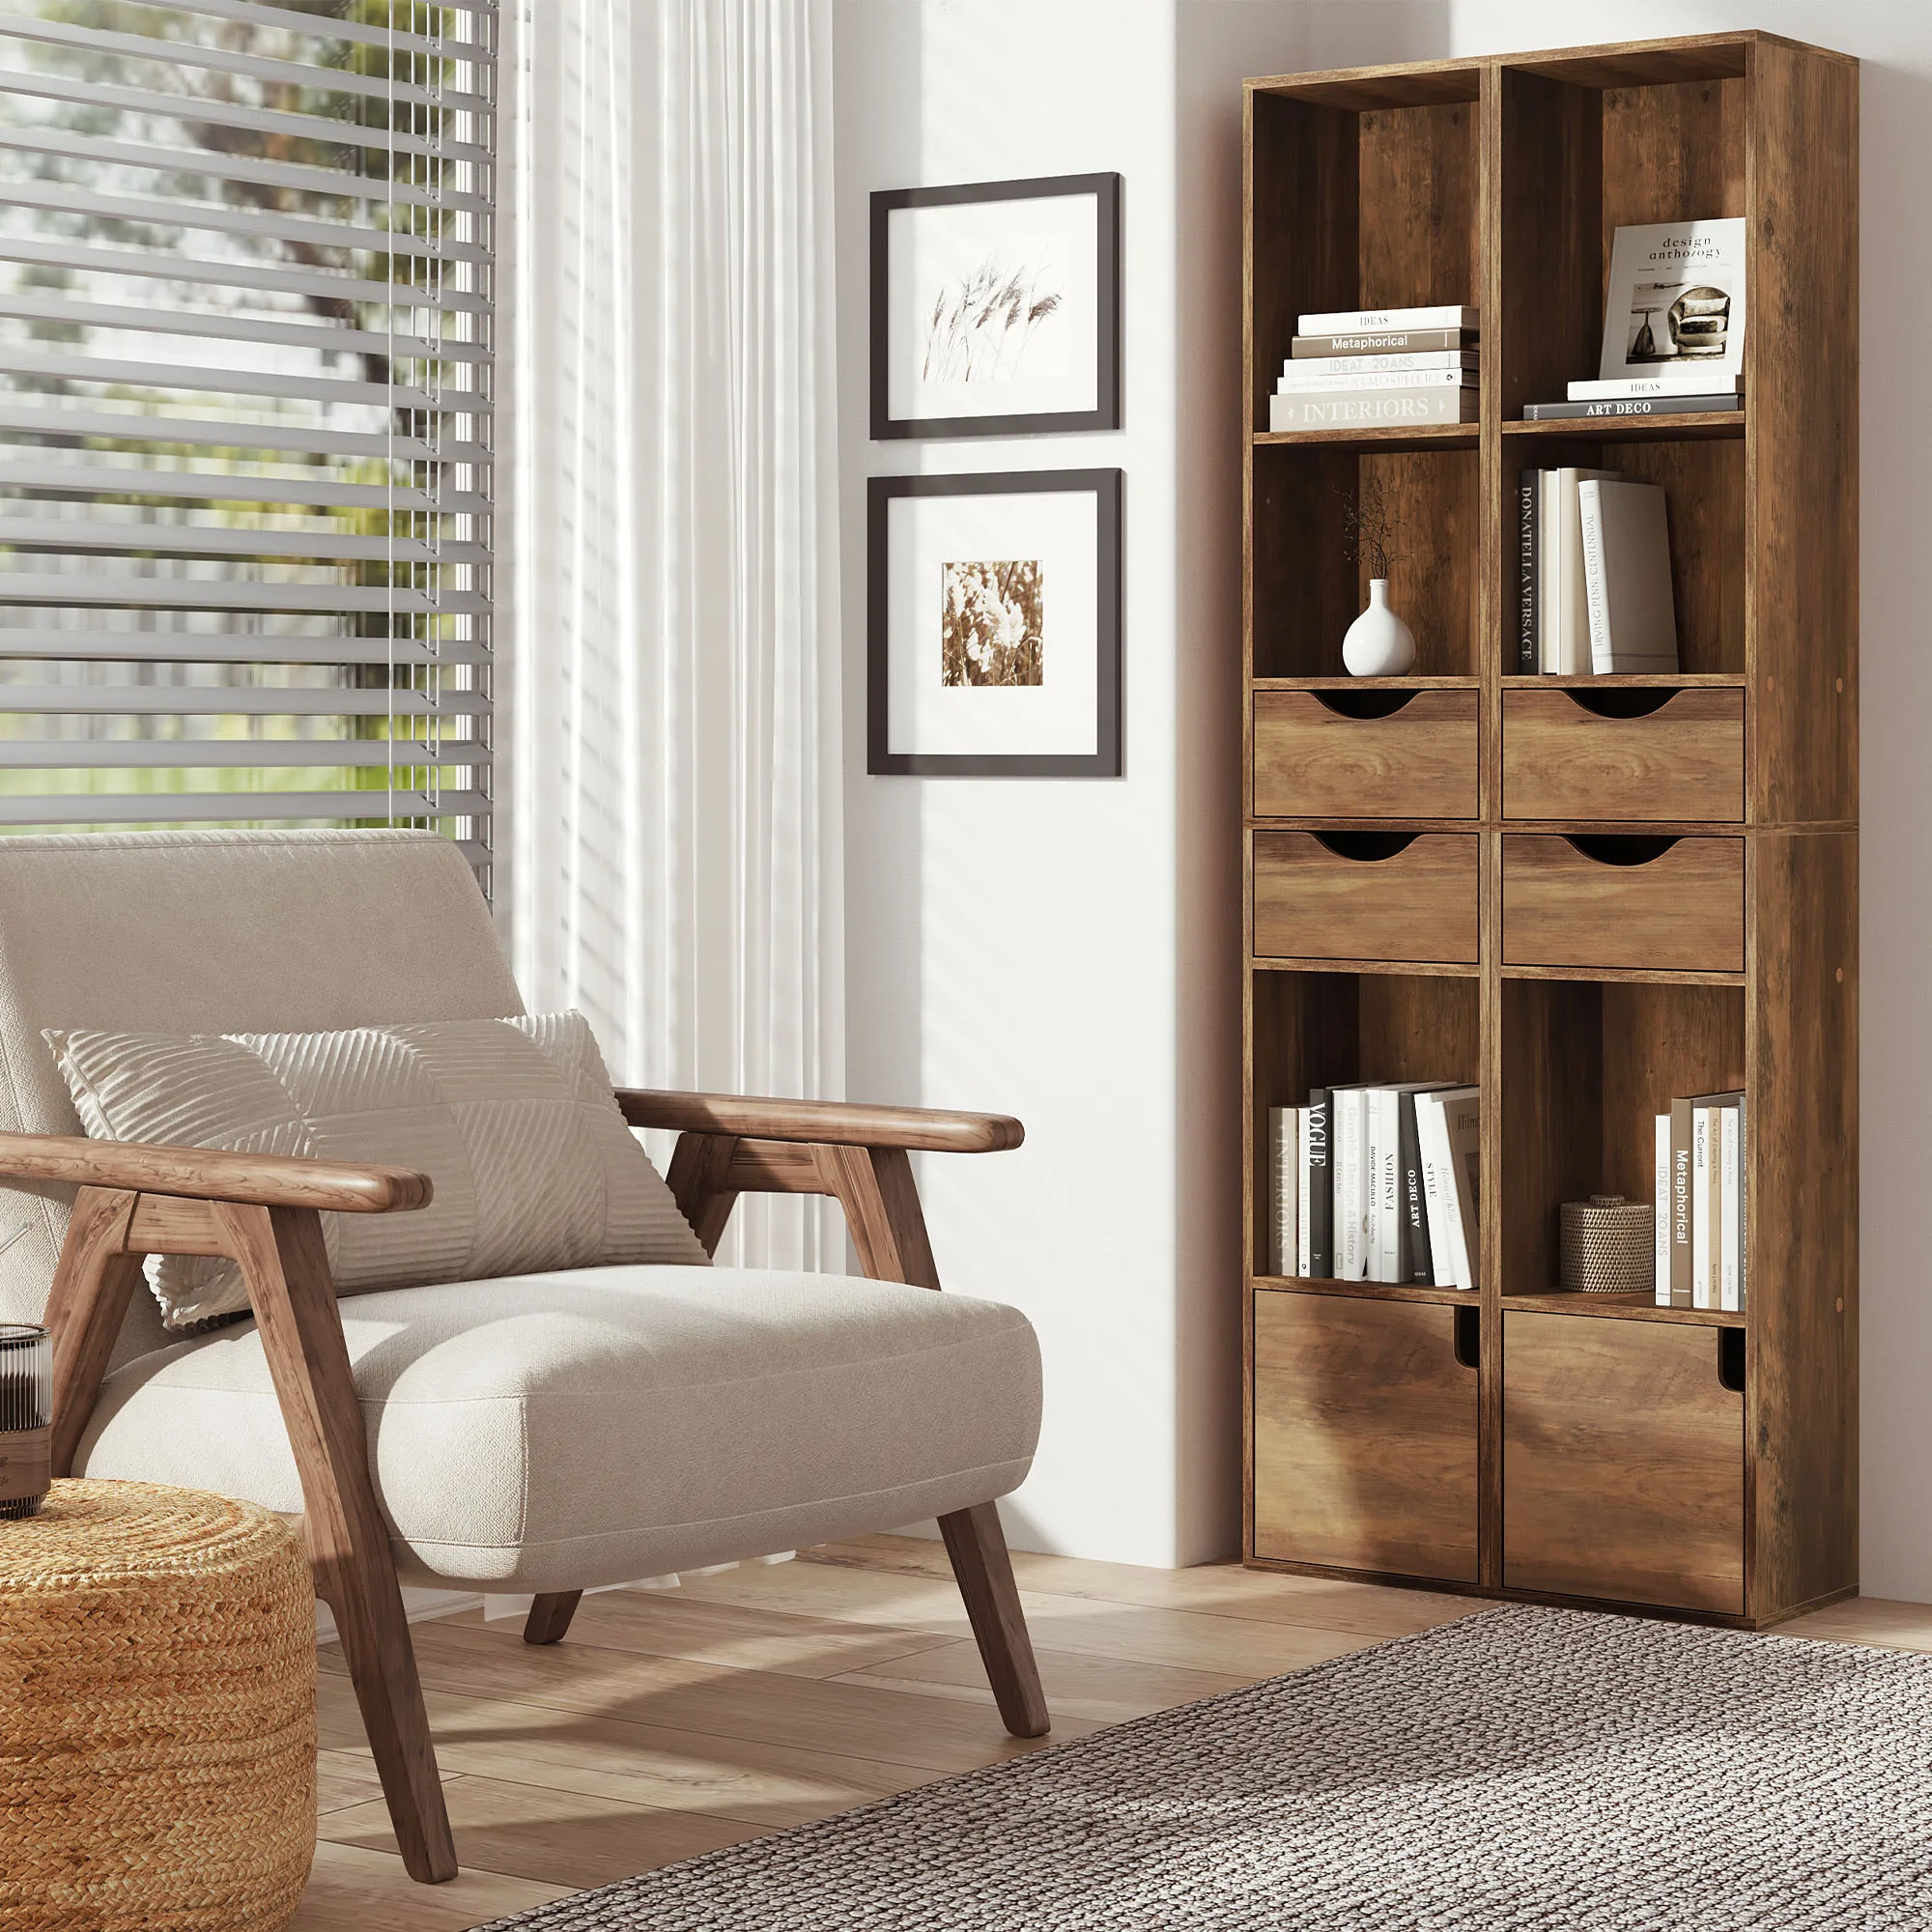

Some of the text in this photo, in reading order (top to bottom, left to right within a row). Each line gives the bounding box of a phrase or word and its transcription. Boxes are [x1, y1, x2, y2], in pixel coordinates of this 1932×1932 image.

[1649, 247, 1721, 261] anthology
[1662, 235, 1712, 248] design
[1360, 315, 1389, 327] IDEAS
[1331, 334, 1407, 351] Metaphorical
[1329, 358, 1364, 372] IDEAT
[1631, 382, 1661, 393] IDEAS
[1302, 397, 1430, 423] INTERIORS
[1585, 402, 1652, 415] ART DECO
[1585, 514, 1598, 576] CENTENNIAL
[1521, 486, 1532, 660] DONATELLA VERSACE
[1593, 610, 1605, 647] IRVING
[1309, 1103, 1326, 1167] VOGUE
[1275, 1138, 1289, 1249] INTERIORS
[1384, 1153, 1395, 1211] FASHION
[1426, 1162, 1437, 1198] STYLE
[1658, 1166, 1668, 1203] IDEAT
[1675, 1150, 1689, 1244] Metaphorical
[1348, 1209, 1357, 1219] A
[1407, 1169, 1421, 1229] ART DECO
[1346, 1221, 1357, 1265] History
